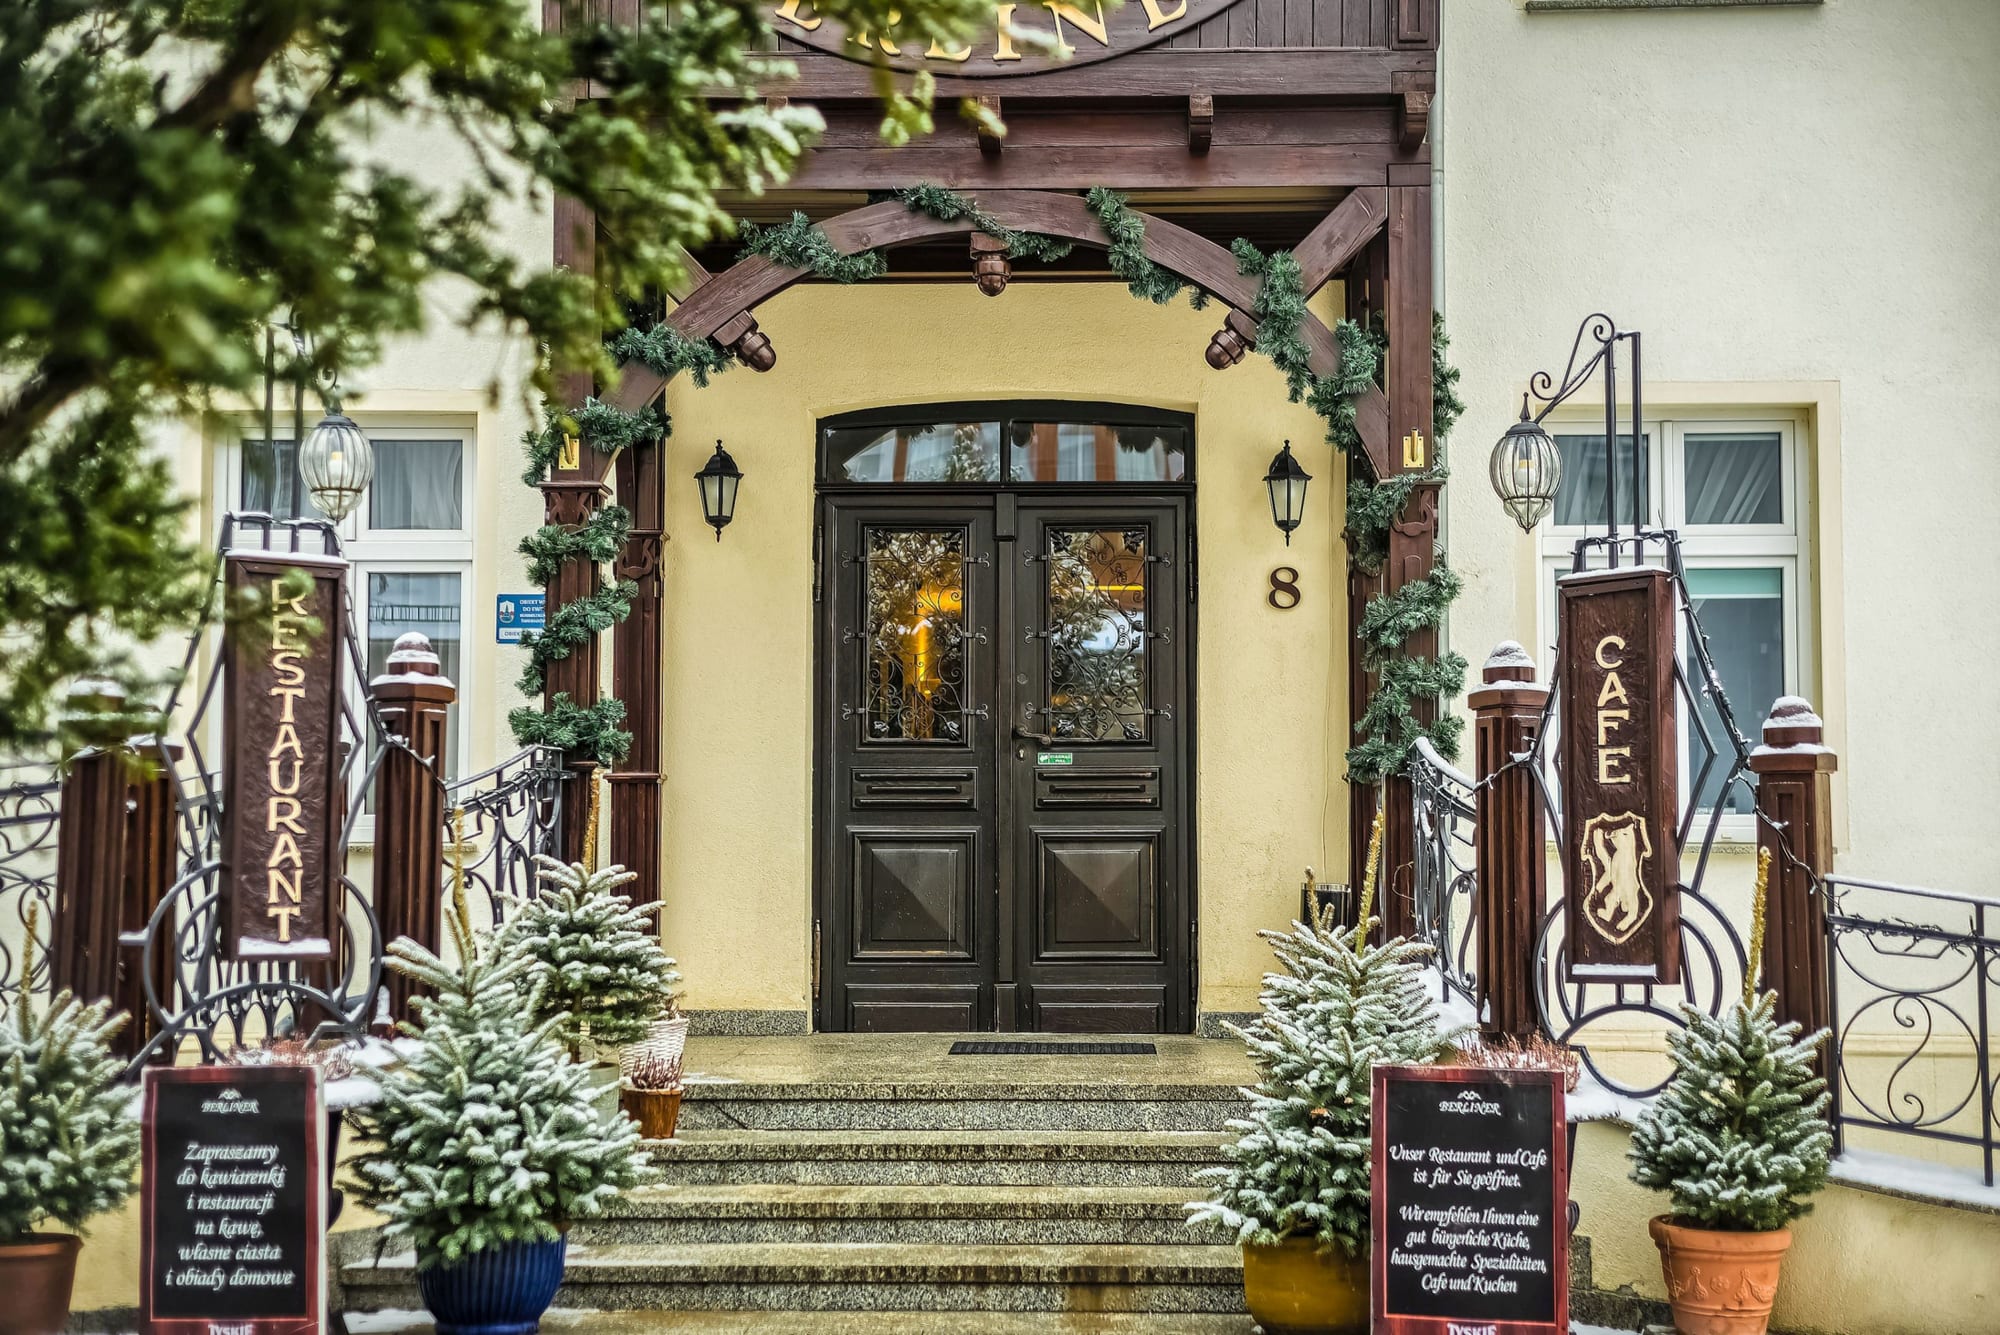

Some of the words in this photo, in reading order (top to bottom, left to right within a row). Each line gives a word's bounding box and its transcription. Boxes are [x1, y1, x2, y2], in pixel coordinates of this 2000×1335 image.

[1268, 566, 1301, 609] 8
[1595, 634, 1631, 785] CAFE
[266, 579, 307, 942] RESTAURANT
[201, 1100, 260, 1114] BERLINER
[1438, 1100, 1502, 1116] BERLINER
[184, 1142, 279, 1165] Zapraszamy
[1389, 1144, 1426, 1163] Unser
[1428, 1146, 1492, 1165] Restaurant
[1496, 1148, 1520, 1165] und
[176, 1166, 198, 1185] do
[200, 1164, 287, 1188] kawiarenki
[1413, 1167, 1428, 1184] ist
[1428, 1167, 1452, 1189] für
[1453, 1169, 1473, 1186] Sie
[1472, 1169, 1522, 1191] geöffnet.
[186, 1191, 195, 1210] i
[197, 1191, 276, 1215] restauracji
[1399, 1204, 1424, 1222] Wir
[1423, 1205, 1481, 1227] empfehlen
[1480, 1207, 1516, 1226] Ihnen
[1516, 1210, 1540, 1226] eine
[195, 1220, 215, 1235] na
[1404, 1230, 1427, 1248] gut
[1431, 1227, 1492, 1249] bürgerliche
[178, 1241, 232, 1261] własne
[235, 1243, 283, 1261] ciasta
[1390, 1247, 1468, 1271] hausgemachte
[1470, 1252, 1548, 1274] Spezialitäten,
[165, 1268, 173, 1287] i
[175, 1267, 226, 1292] obiady
[229, 1267, 295, 1287] domowe
[1449, 1272, 1475, 1292] und
[1472, 1274, 1518, 1295] Kuchen
